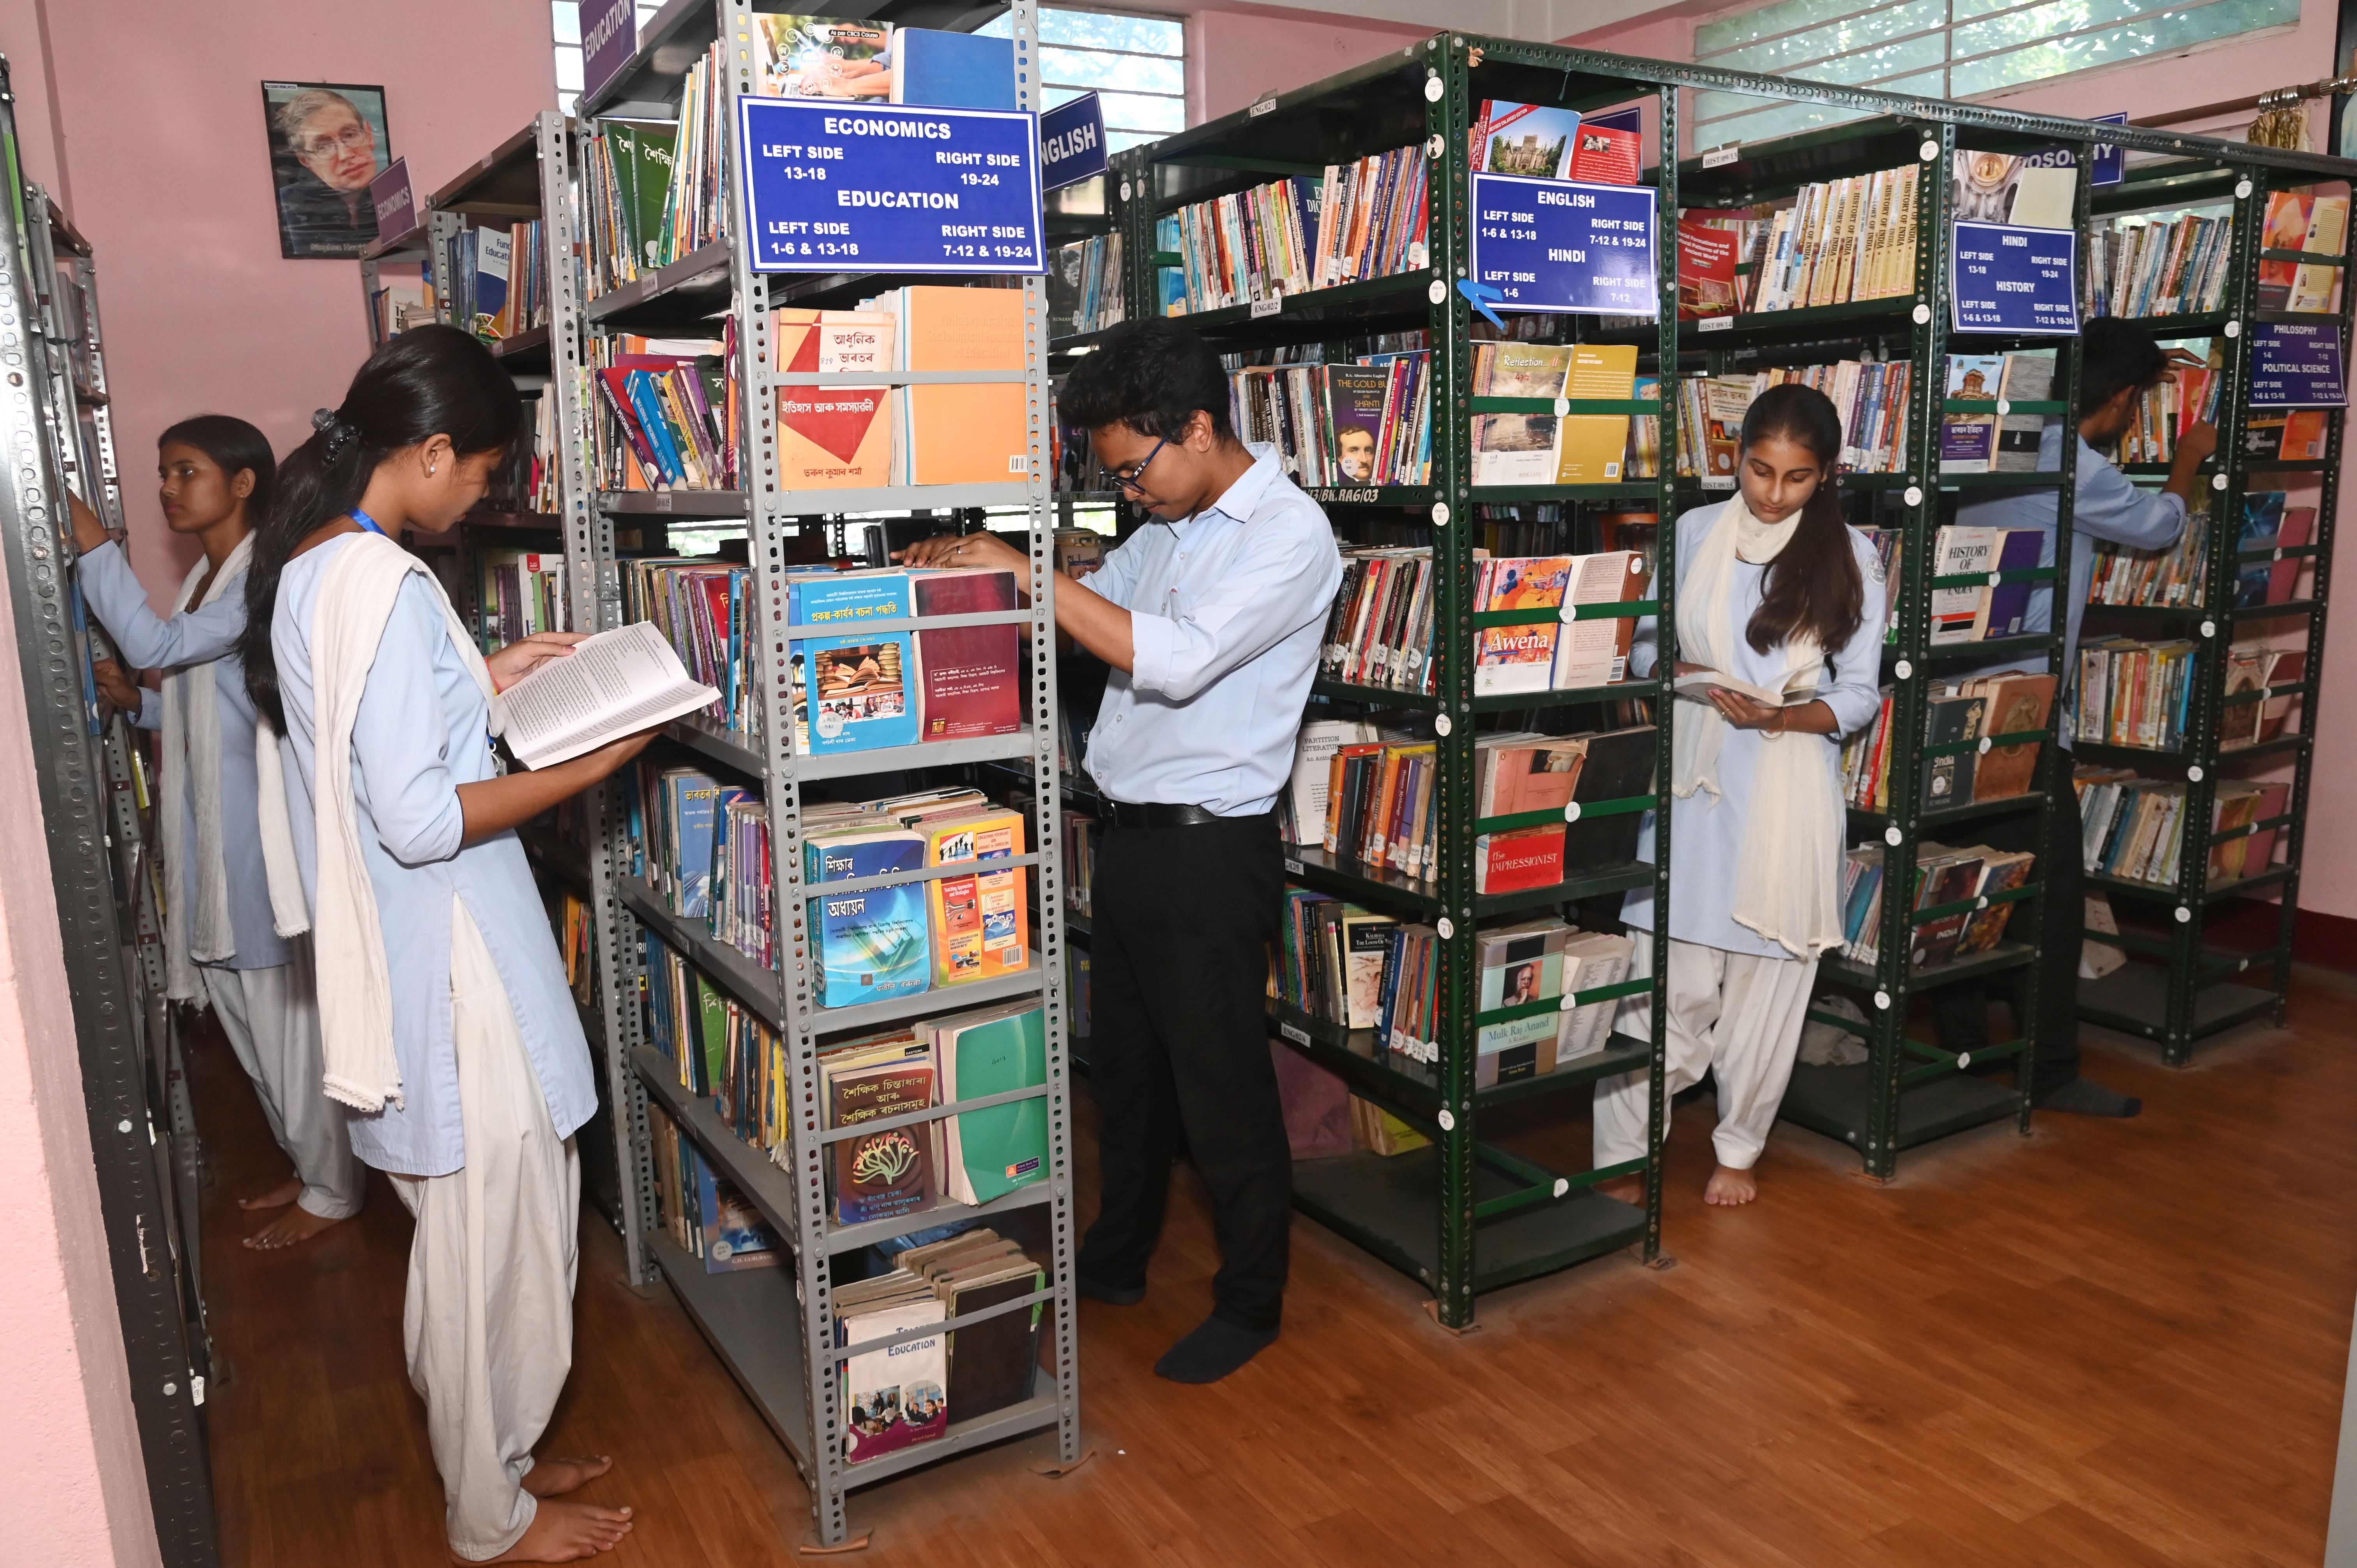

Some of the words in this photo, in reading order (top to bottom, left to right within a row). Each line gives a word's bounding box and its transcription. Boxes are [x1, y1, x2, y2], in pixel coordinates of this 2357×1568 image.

[585, 0, 631, 63] EDUCATION
[1252, 100, 1275, 116] ENG/02/1
[1516, 108, 1528, 117] EDITION
[825, 118, 951, 139] ECONOMICS
[1041, 123, 1097, 166] NGLISH
[763, 145, 802, 157] LEFT
[807, 147, 843, 159] SIDE
[936, 152, 982, 166] RIGHT
[987, 154, 1020, 166] SIDE
[784, 167, 826, 180] 13-18
[961, 173, 999, 185] 19-24
[838, 191, 958, 208] EDUCATION
[1538, 191, 1594, 208] ENGLISH
[1901, 181, 1912, 212] HISTORY
[377, 186, 411, 222] ECONOMICS
[1484, 210, 1509, 221] LEFT
[1512, 212, 1534, 222] SIDE
[1900, 215, 1906, 224] OF
[769, 222, 808, 234] LEFT
[814, 222, 850, 234] SIDE
[942, 225, 987, 238] RIGHT
[993, 226, 1025, 238] SIDE
[1297, 210, 1306, 249] DICKINSON
[1592, 219, 1621, 229] RIGHT
[1624, 221, 1644, 231] SIDE
[1482, 228, 1497, 237] 1-6
[1500, 229, 1507, 238] &
[1511, 230, 1536, 240] 13-18
[1897, 226, 1905, 246] INDIA
[1590, 235, 1609, 245] 7-12
[1612, 237, 1618, 245] &
[1622, 237, 1646, 247] 19-24
[2003, 236, 2027, 247] HINDI
[772, 243, 795, 254] 1-6
[800, 243, 812, 254] &
[818, 243, 859, 255] 13-18
[944, 245, 974, 256] 7-12
[979, 245, 989, 256] &
[995, 246, 1032, 257] 19-24
[1549, 249, 1585, 262] HINDI
[1684, 247, 1702, 257] Ancient
[1979, 253, 1993, 261] SIDE
[1485, 271, 1509, 281] LEFT
[1513, 272, 1535, 282] SIDE
[1593, 277, 1622, 286] RIGHT
[1625, 279, 1645, 288] SIDE
[1504, 288, 1518, 297] 1-6
[1997, 281, 2035, 292] HISTORY
[1611, 293, 1630, 302] 7-12
[1255, 302, 1278, 313] ENG/02/2
[2274, 325, 2317, 334] PHILOSOPHY
[833, 333, 876, 348] আধুনিক
[839, 353, 875, 364] ভাৰতৰ
[2263, 364, 2300, 372] POLITICAL
[2302, 365, 2330, 373] SCIENCE
[1353, 380, 1376, 388] GOLD
[1387, 378, 1398, 419] Emotions
[601, 379, 619, 411] EDUCATIONAL
[617, 406, 635, 441] PSYCHOLOGY
[781, 399, 811, 414] ইতিহাস
[814, 402, 834, 413] আৰু
[1304, 487, 1379, 503] /13/BK.RAG/03
[1949, 545, 1989, 559] HISTORY
[1959, 559, 1974, 570] OF
[1488, 632, 1548, 652] Awena
[1304, 736, 1339, 745] PARTITION
[825, 855, 854, 874] শিক্ষাৰ
[1491, 853, 1557, 873] IMPRESSIONIST
[827, 898, 866, 917] অধ্যয়ন
[1488, 1028, 1508, 1042] Mulk
[1510, 1024, 1523, 1037] Raj
[1524, 1017, 1549, 1032] Anand
[842, 1084, 880, 1099] শৈক্ষিক
[876, 1092, 900, 1103] আৰু
[840, 1109, 877, 1124] শৈক্ষিক
